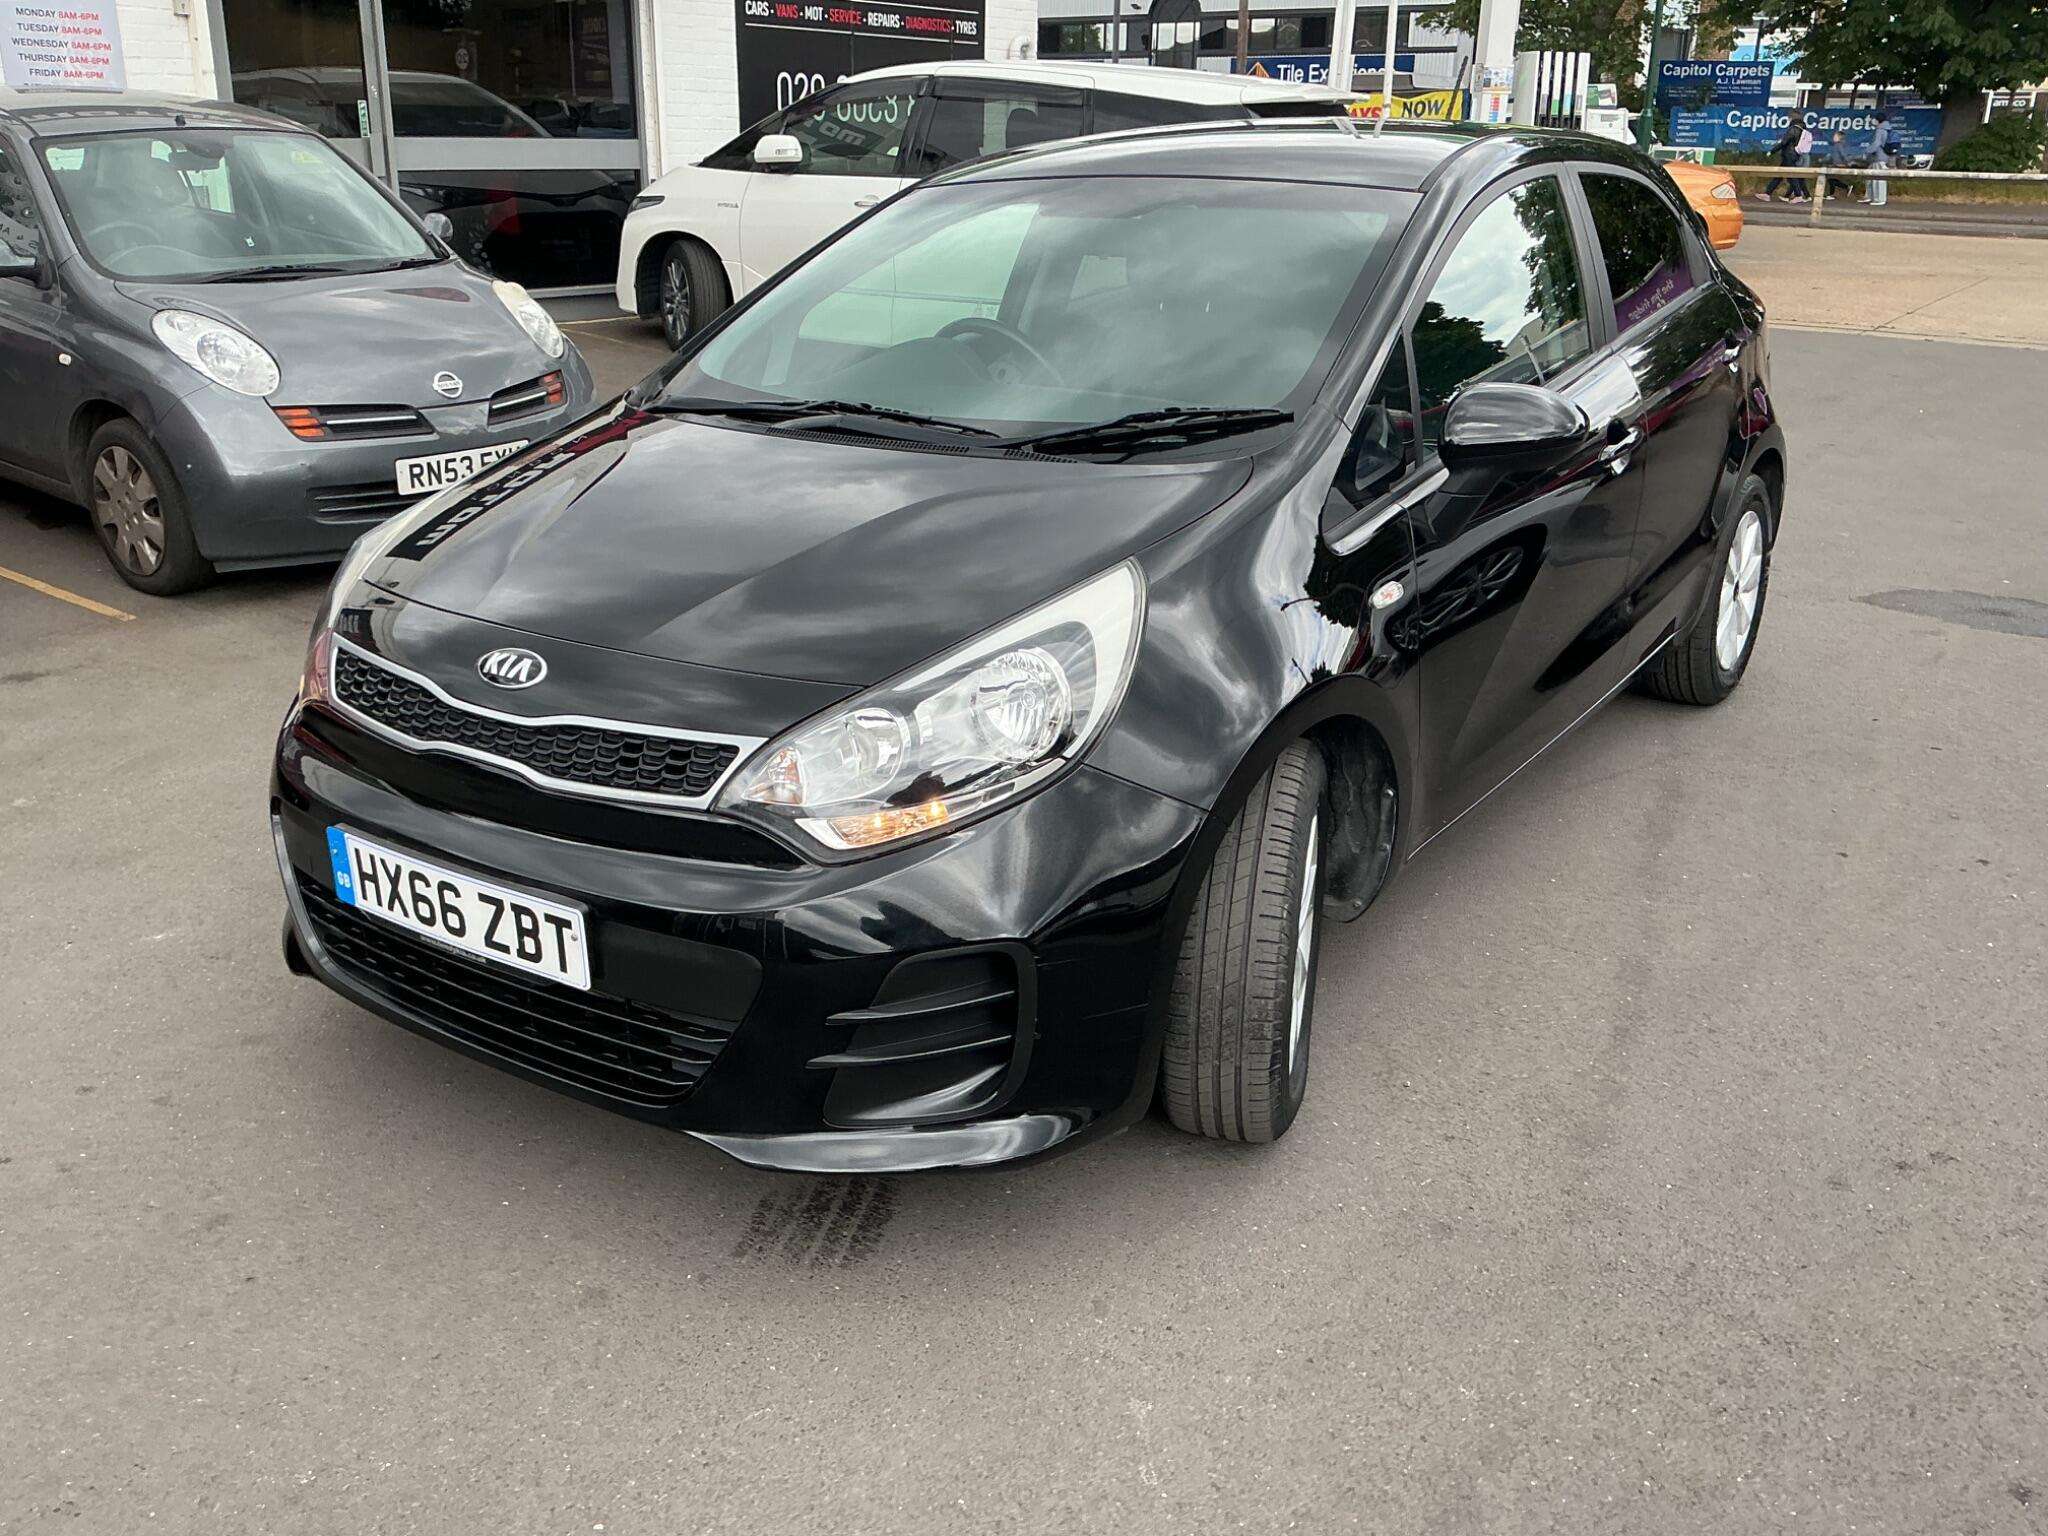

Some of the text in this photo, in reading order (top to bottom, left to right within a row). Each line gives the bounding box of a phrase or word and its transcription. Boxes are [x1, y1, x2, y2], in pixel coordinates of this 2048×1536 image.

[15, 7, 100, 21] MONDAY 8AM-6PM
[745, 0, 977, 35] CARS VANS MOT SERVICE REPAIRS DIAGNOSTICS TYRES
[17, 22, 103, 36] TUESDAY 8AM-6PM
[11, 37, 112, 52] WEDNESDAY 8AM-6PM
[18, 52, 110, 66] THURSDAY 8AM-6PM
[29, 68, 104, 80] FRIDAY 8AM-6PM
[1277, 64, 1304, 83] Tile
[1662, 63, 1770, 79] Capitol Carpets
[1731, 77, 1762, 86] Lawman
[1402, 99, 1444, 118] NOW
[1726, 110, 1877, 132] Capito Carpets
[408, 455, 474, 489] RN53
[483, 652, 532, 682] KIA
[354, 848, 573, 974] HX66 ZBT
